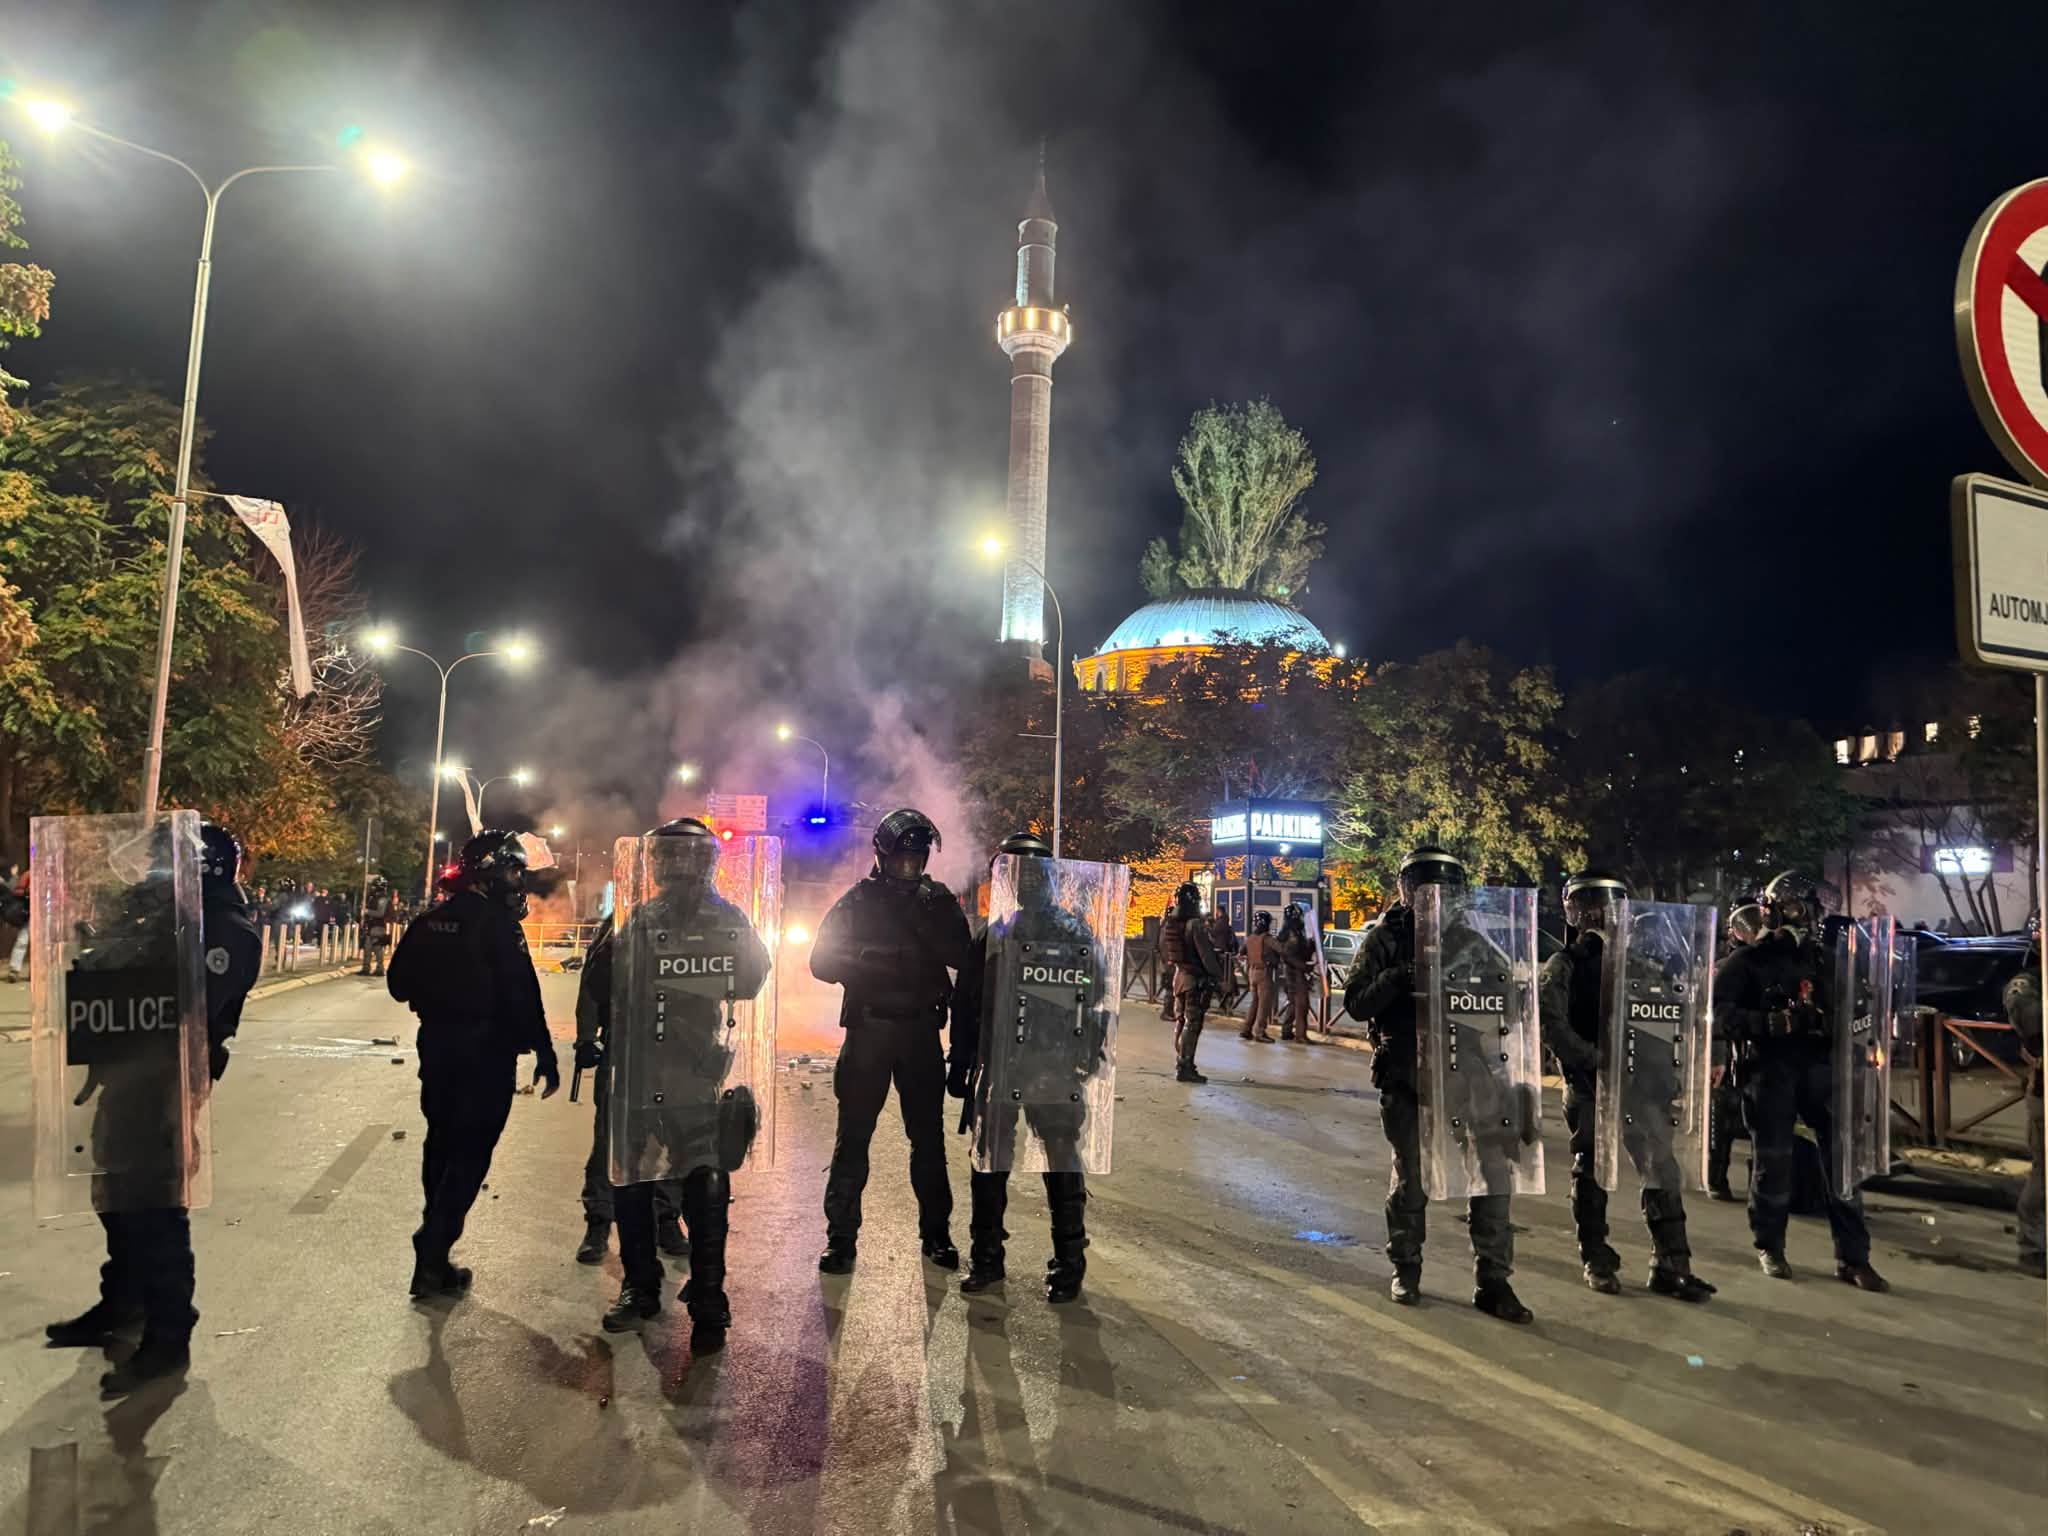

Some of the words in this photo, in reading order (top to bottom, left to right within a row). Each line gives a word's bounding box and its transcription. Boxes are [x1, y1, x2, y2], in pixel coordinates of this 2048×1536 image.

[1250, 812, 1321, 838] PARKING
[660, 956, 734, 975] POLICE
[1023, 966, 1085, 984] POLICE
[1450, 995, 1504, 1011] POLICE
[1631, 1003, 1681, 1019] POLICE
[70, 996, 177, 1033] POLICE
[1848, 1014, 1872, 1033] OLICE
